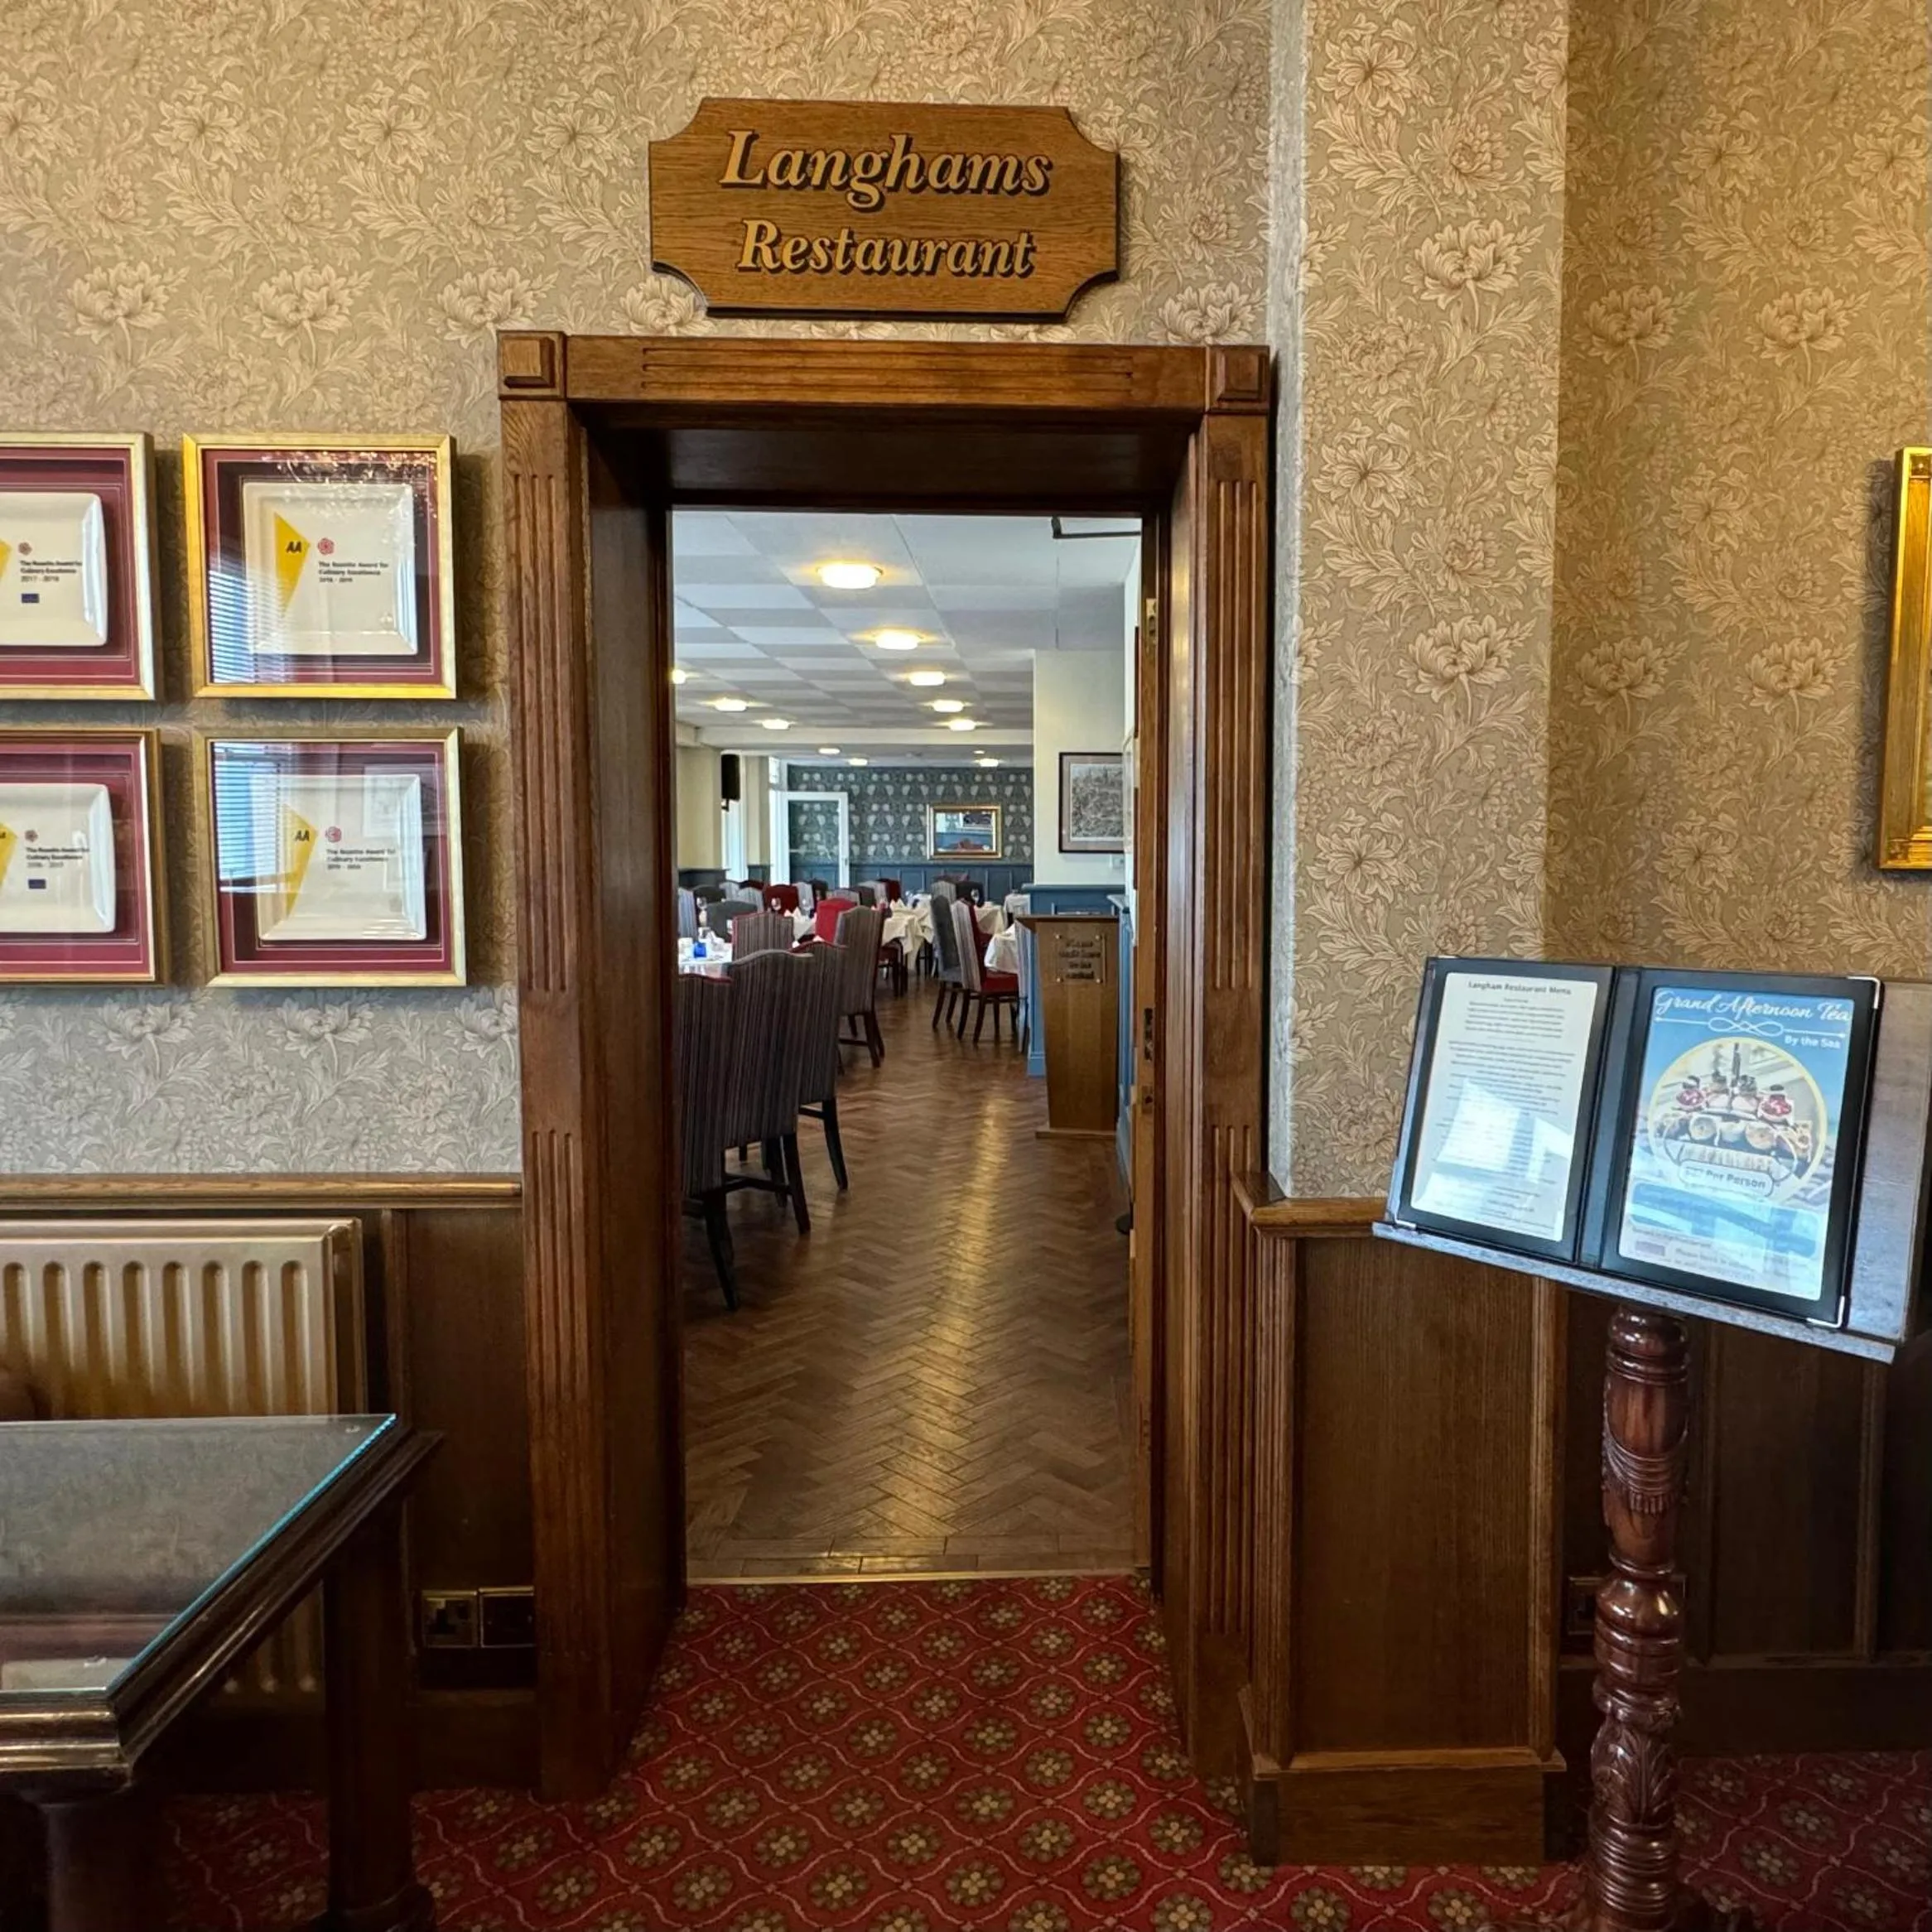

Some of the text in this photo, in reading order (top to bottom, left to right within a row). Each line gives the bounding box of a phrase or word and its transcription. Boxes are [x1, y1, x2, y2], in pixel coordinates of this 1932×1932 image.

[719, 129, 1053, 212] Langhams
[737, 219, 1037, 277] Restaurant
[286, 541, 302, 553] AA
[295, 829, 310, 841] AA
[1467, 981, 1572, 995] Langham Restaurant Menu
[1655, 990, 1852, 1021] Grand Afternoon Tea
[1785, 1035, 1841, 1049] By the Sea
[1727, 1174, 1766, 1188] Person
